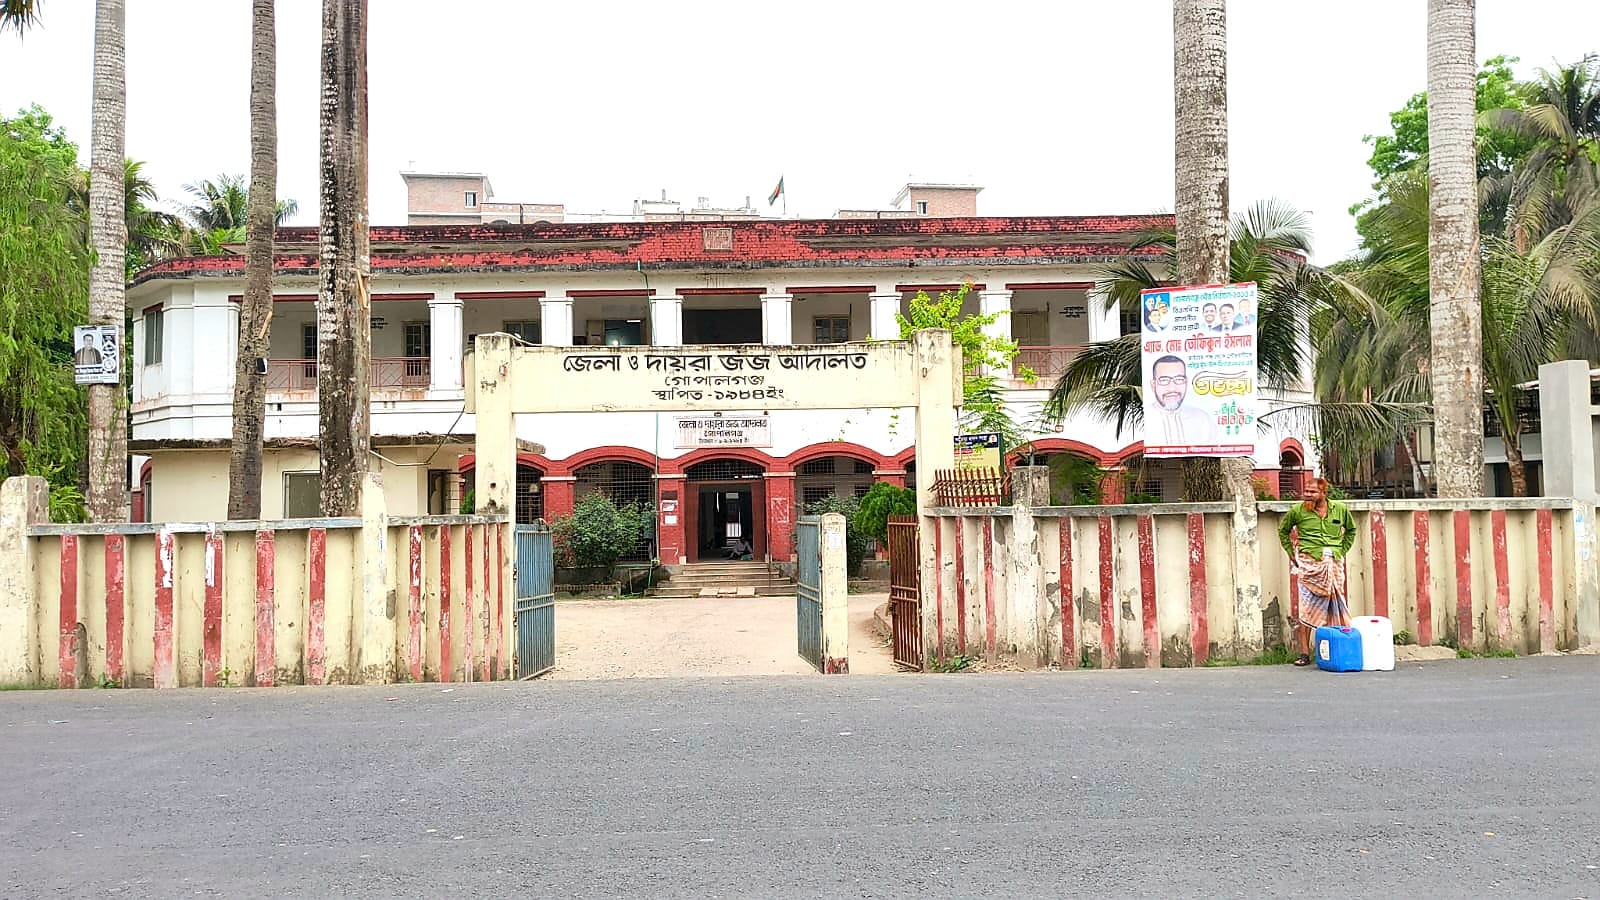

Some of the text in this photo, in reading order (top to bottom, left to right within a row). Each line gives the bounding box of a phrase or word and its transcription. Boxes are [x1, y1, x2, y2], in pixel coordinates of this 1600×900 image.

[1166, 339, 1182, 353] মোঃ
[1184, 332, 1222, 353] তৌফিকুল
[1224, 333, 1252, 349] ইসলাম
[563, 352, 869, 372] জেলা ও দায়রা জজ আদালত
[664, 375, 765, 387] গোপালগঞ্জ
[651, 387, 703, 401] স্থাপিত
[679, 419, 768, 430] জেলা ও দায়রা জজ আদালত
[703, 430, 744, 438] গোপালগঞ্জ
